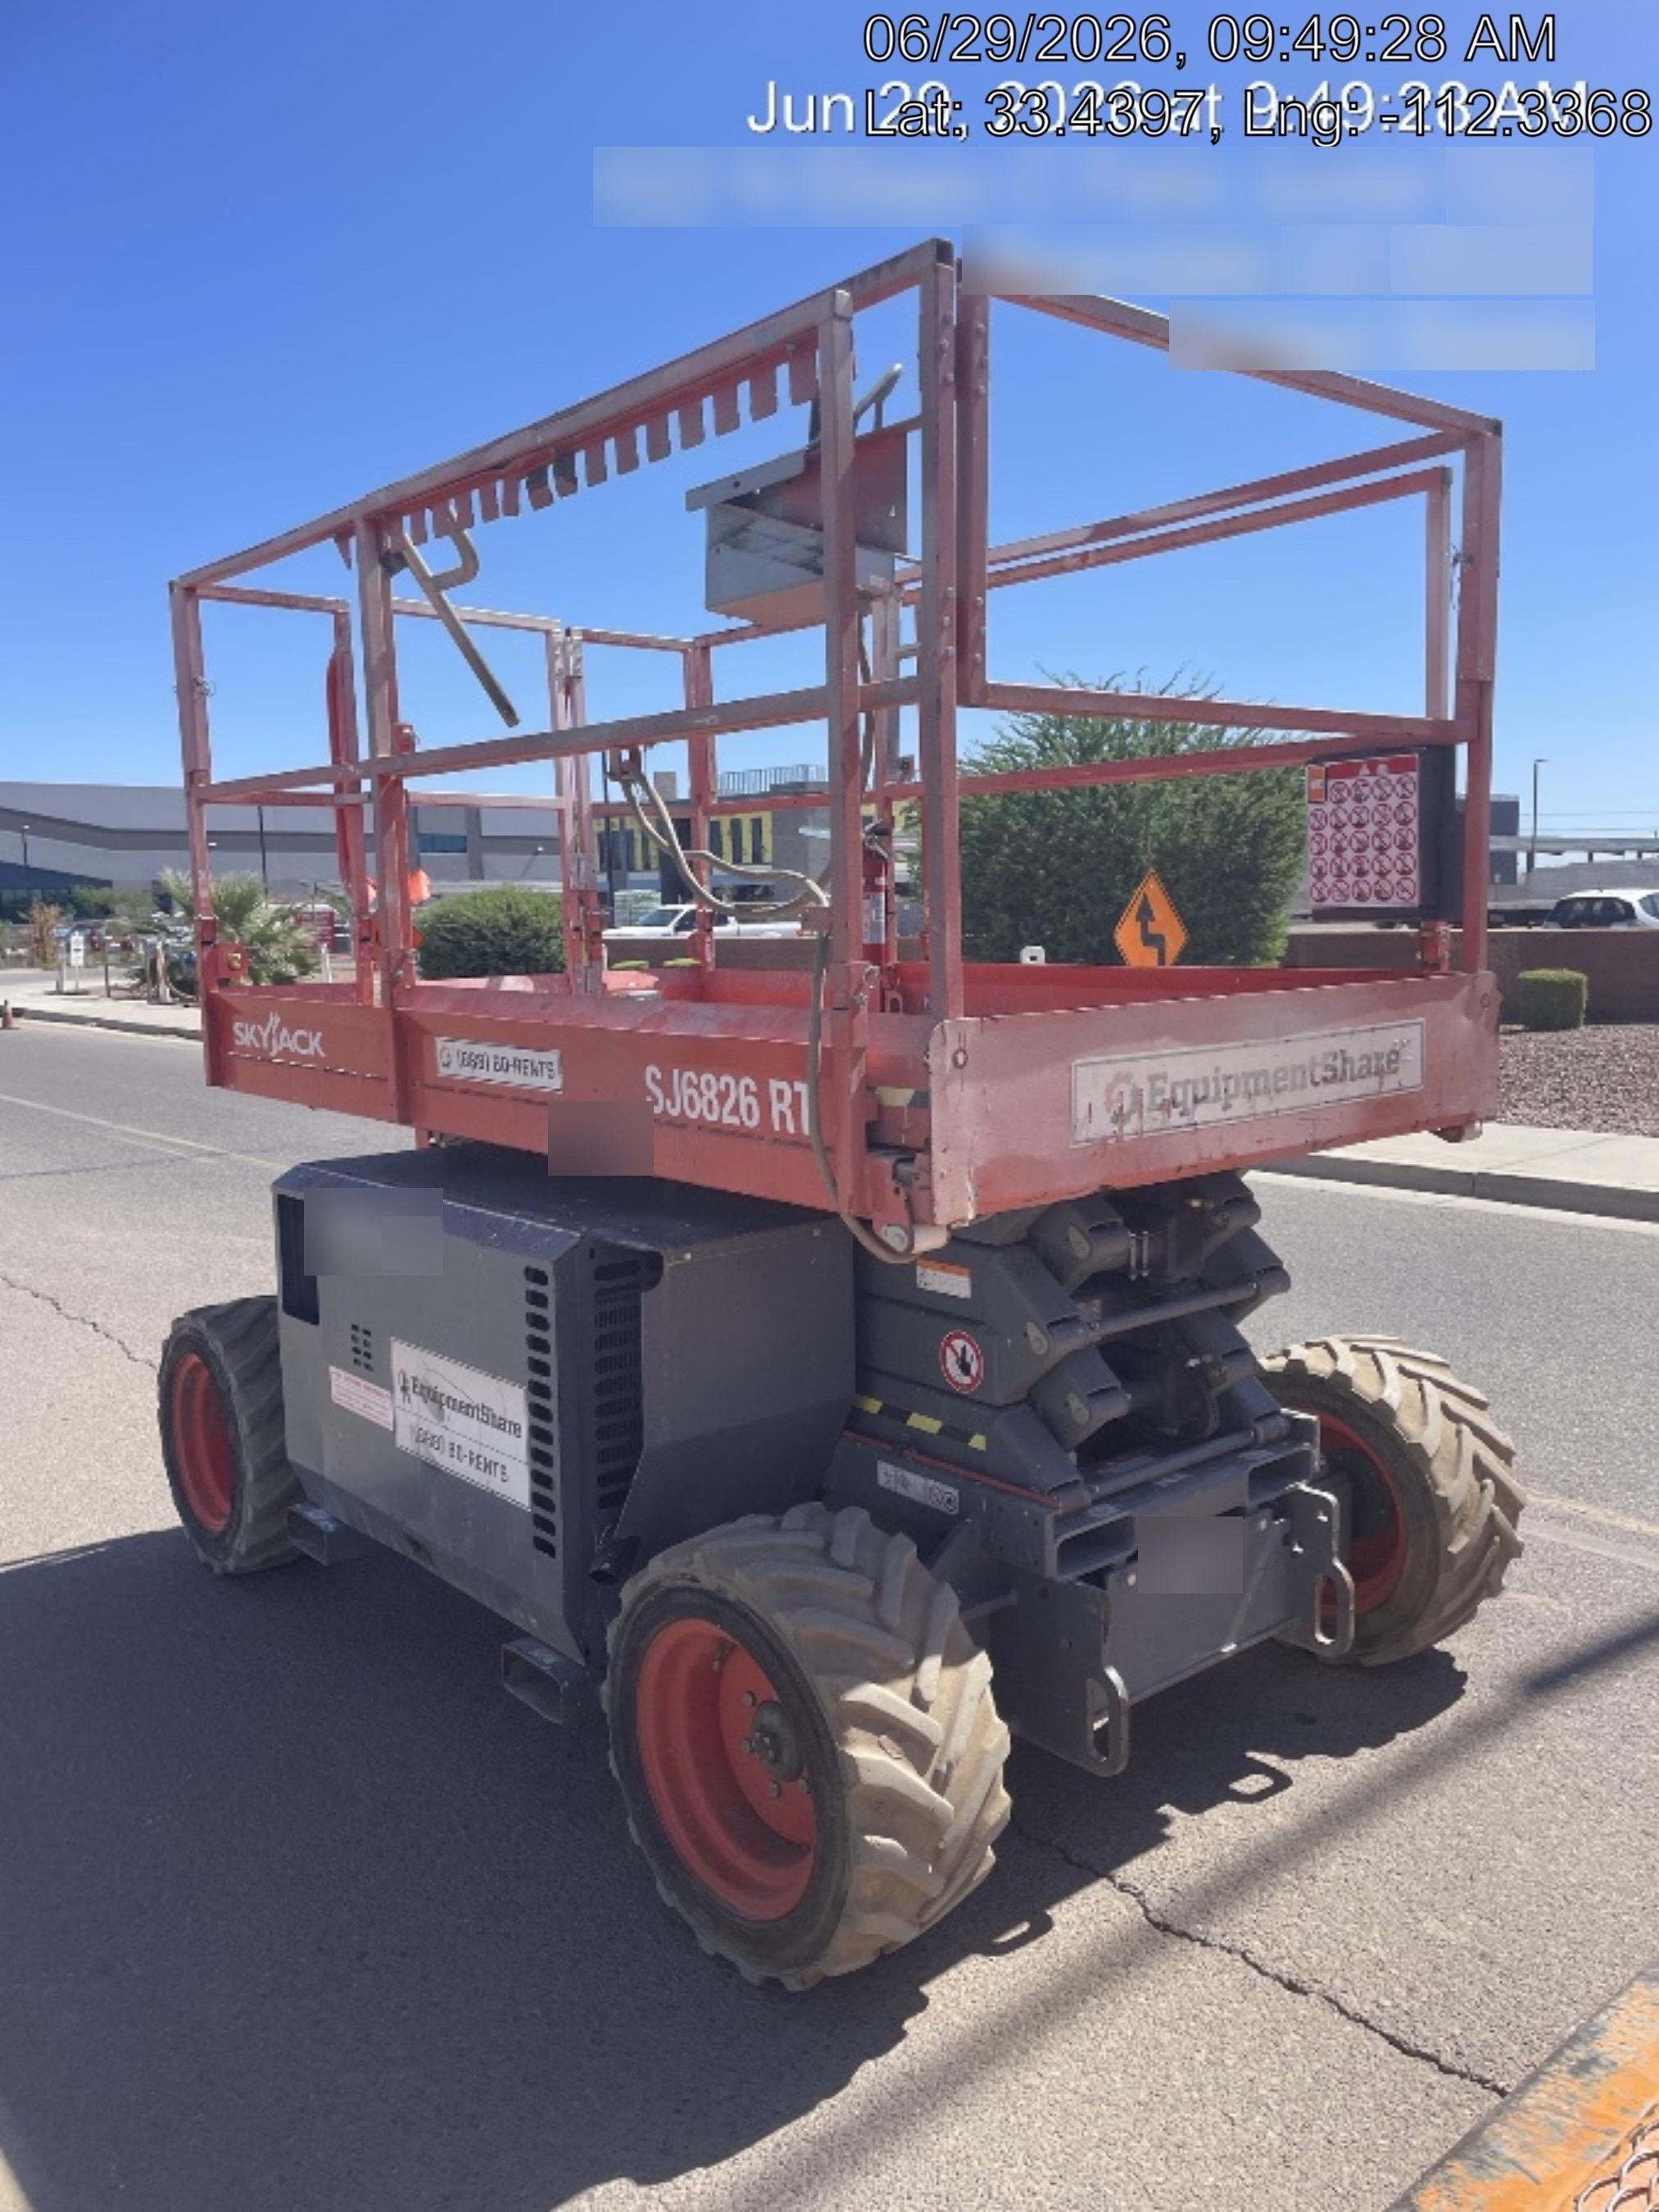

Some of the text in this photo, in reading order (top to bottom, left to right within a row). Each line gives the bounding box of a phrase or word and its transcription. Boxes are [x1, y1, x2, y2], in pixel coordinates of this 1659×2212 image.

[233, 1011, 325, 1058] SKYJACK
[645, 1064, 810, 1135] SJ6826 RT
[1146, 1046, 1401, 1117] EquipmentShare
[411, 1375, 522, 1439] EquipmentShare
